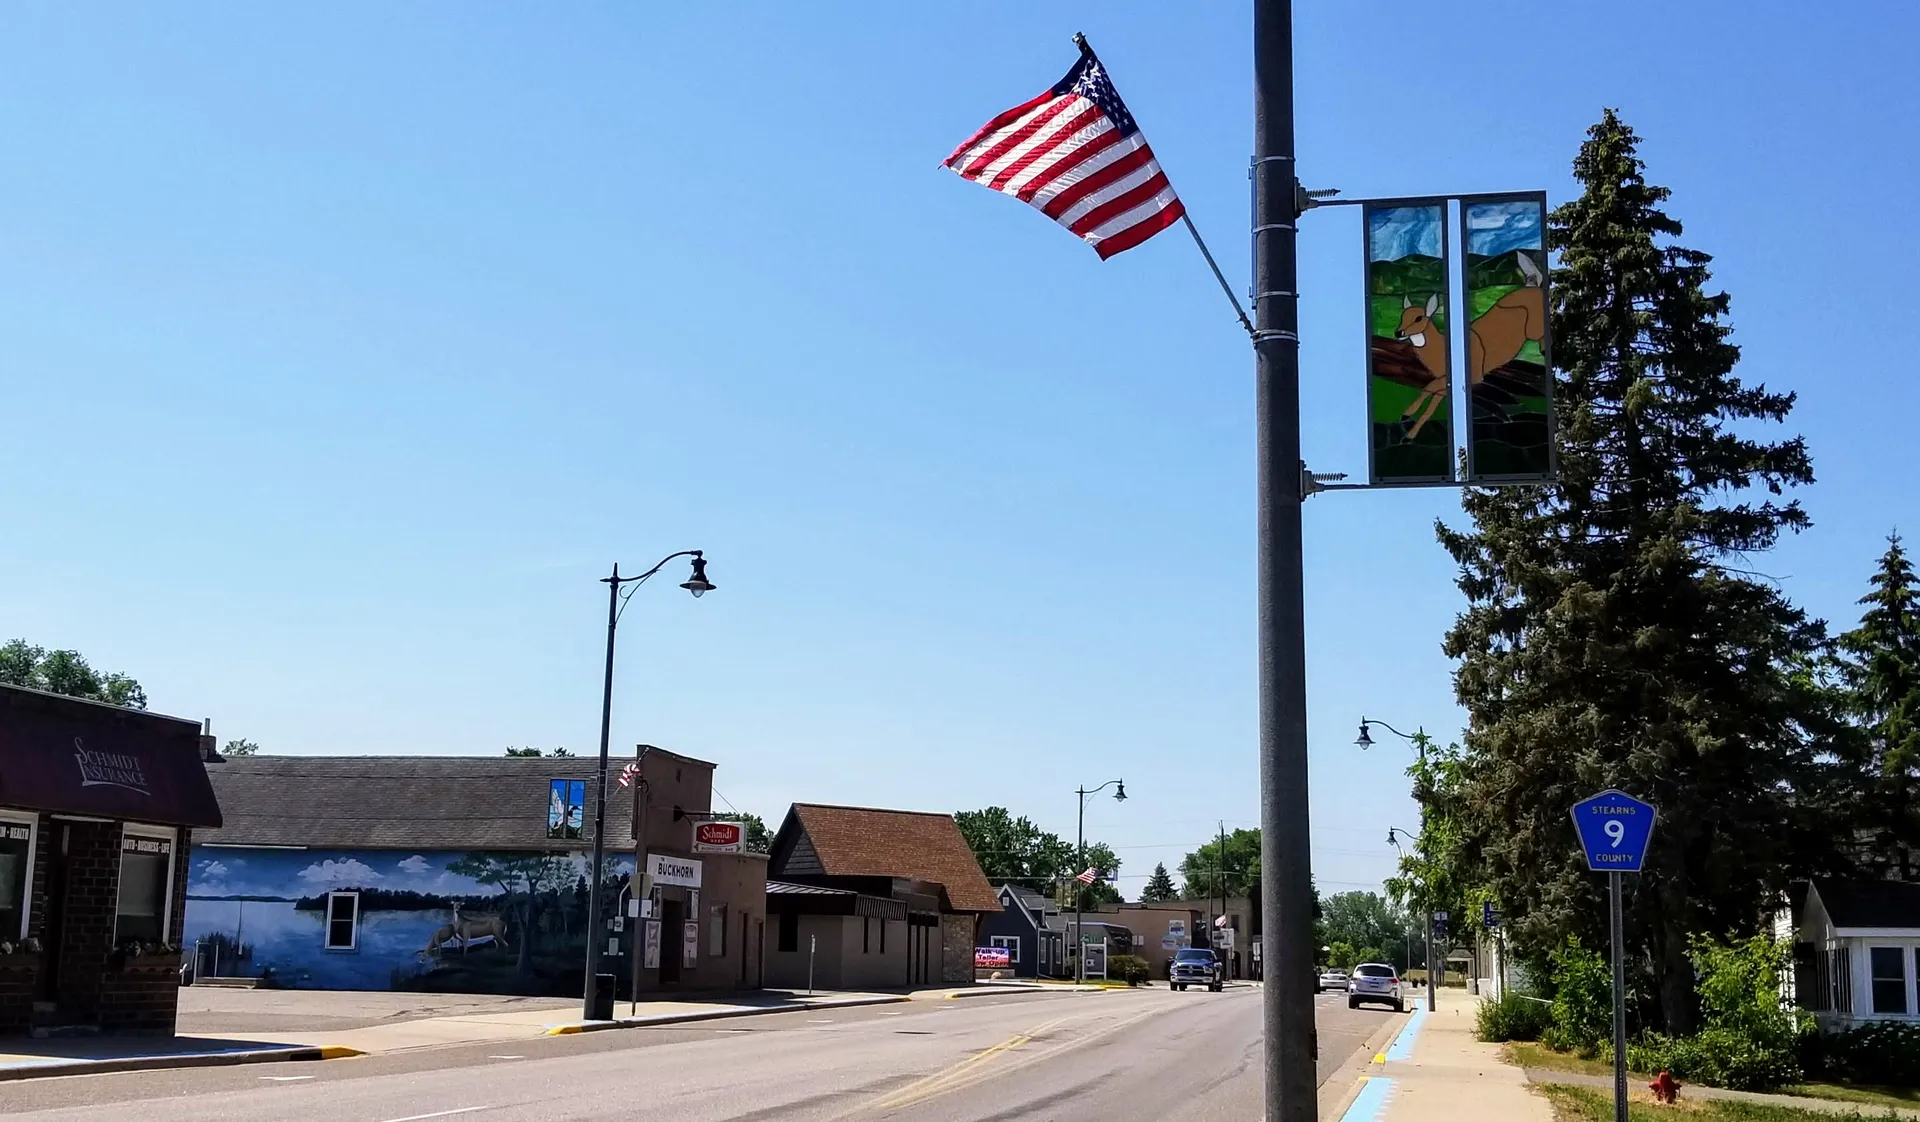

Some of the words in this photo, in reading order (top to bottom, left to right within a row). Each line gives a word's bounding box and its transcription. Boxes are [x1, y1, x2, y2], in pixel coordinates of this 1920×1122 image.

[74, 737, 140, 771] SCHMIDT
[74, 753, 148, 787] INSURANCE
[1592, 806, 1636, 815] STEARNS
[702, 826, 732, 840] Schmidt
[1604, 820, 1624, 848] 9
[1595, 854, 1633, 862] COUNTY
[658, 863, 694, 878] BUCKHORN
